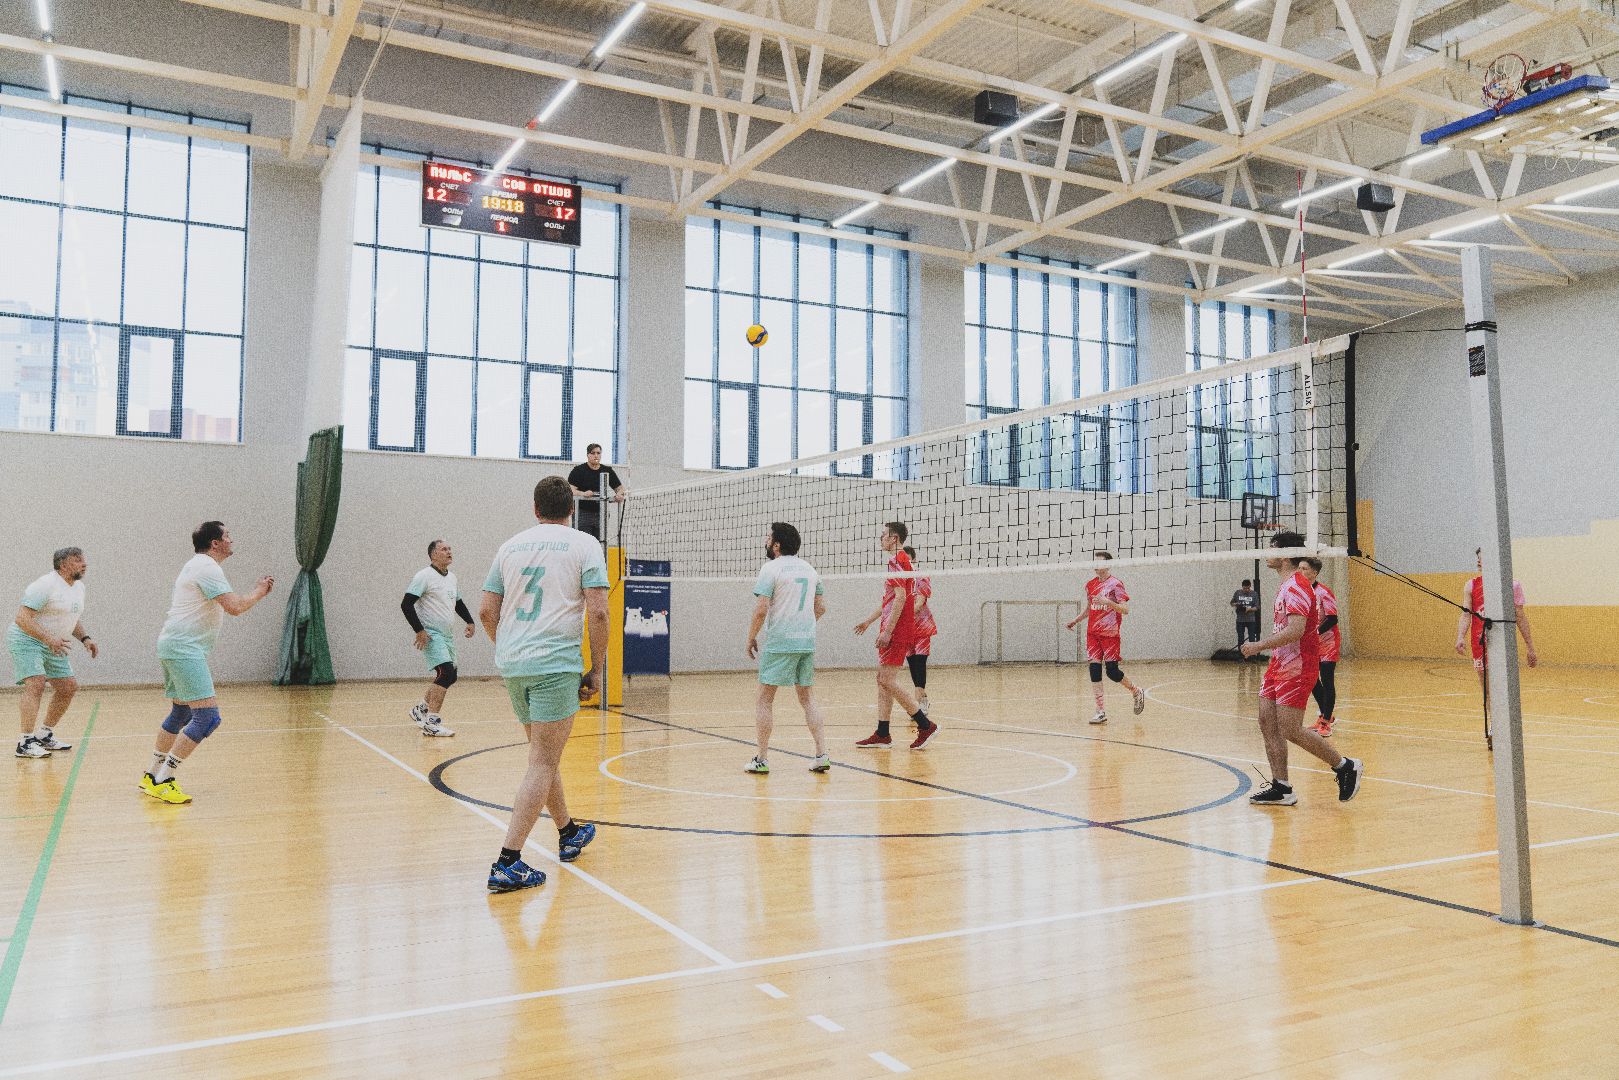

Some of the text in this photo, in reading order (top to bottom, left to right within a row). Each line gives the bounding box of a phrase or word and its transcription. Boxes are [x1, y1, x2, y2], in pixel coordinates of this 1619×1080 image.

[430, 166, 472, 183] ПУЛЬС
[440, 182, 460, 190] СЧЕТ
[426, 187, 447, 202] 12
[482, 196, 524, 212] 19:18
[547, 199, 565, 207] СЧЕТ
[442, 207, 463, 215] ФОЛЫ
[555, 207, 575, 220] 17
[490, 214, 518, 224] ПЕРИОД
[498, 221, 506, 232] 1
[515, 566, 546, 622] 3
[795, 578, 808, 611] 7
